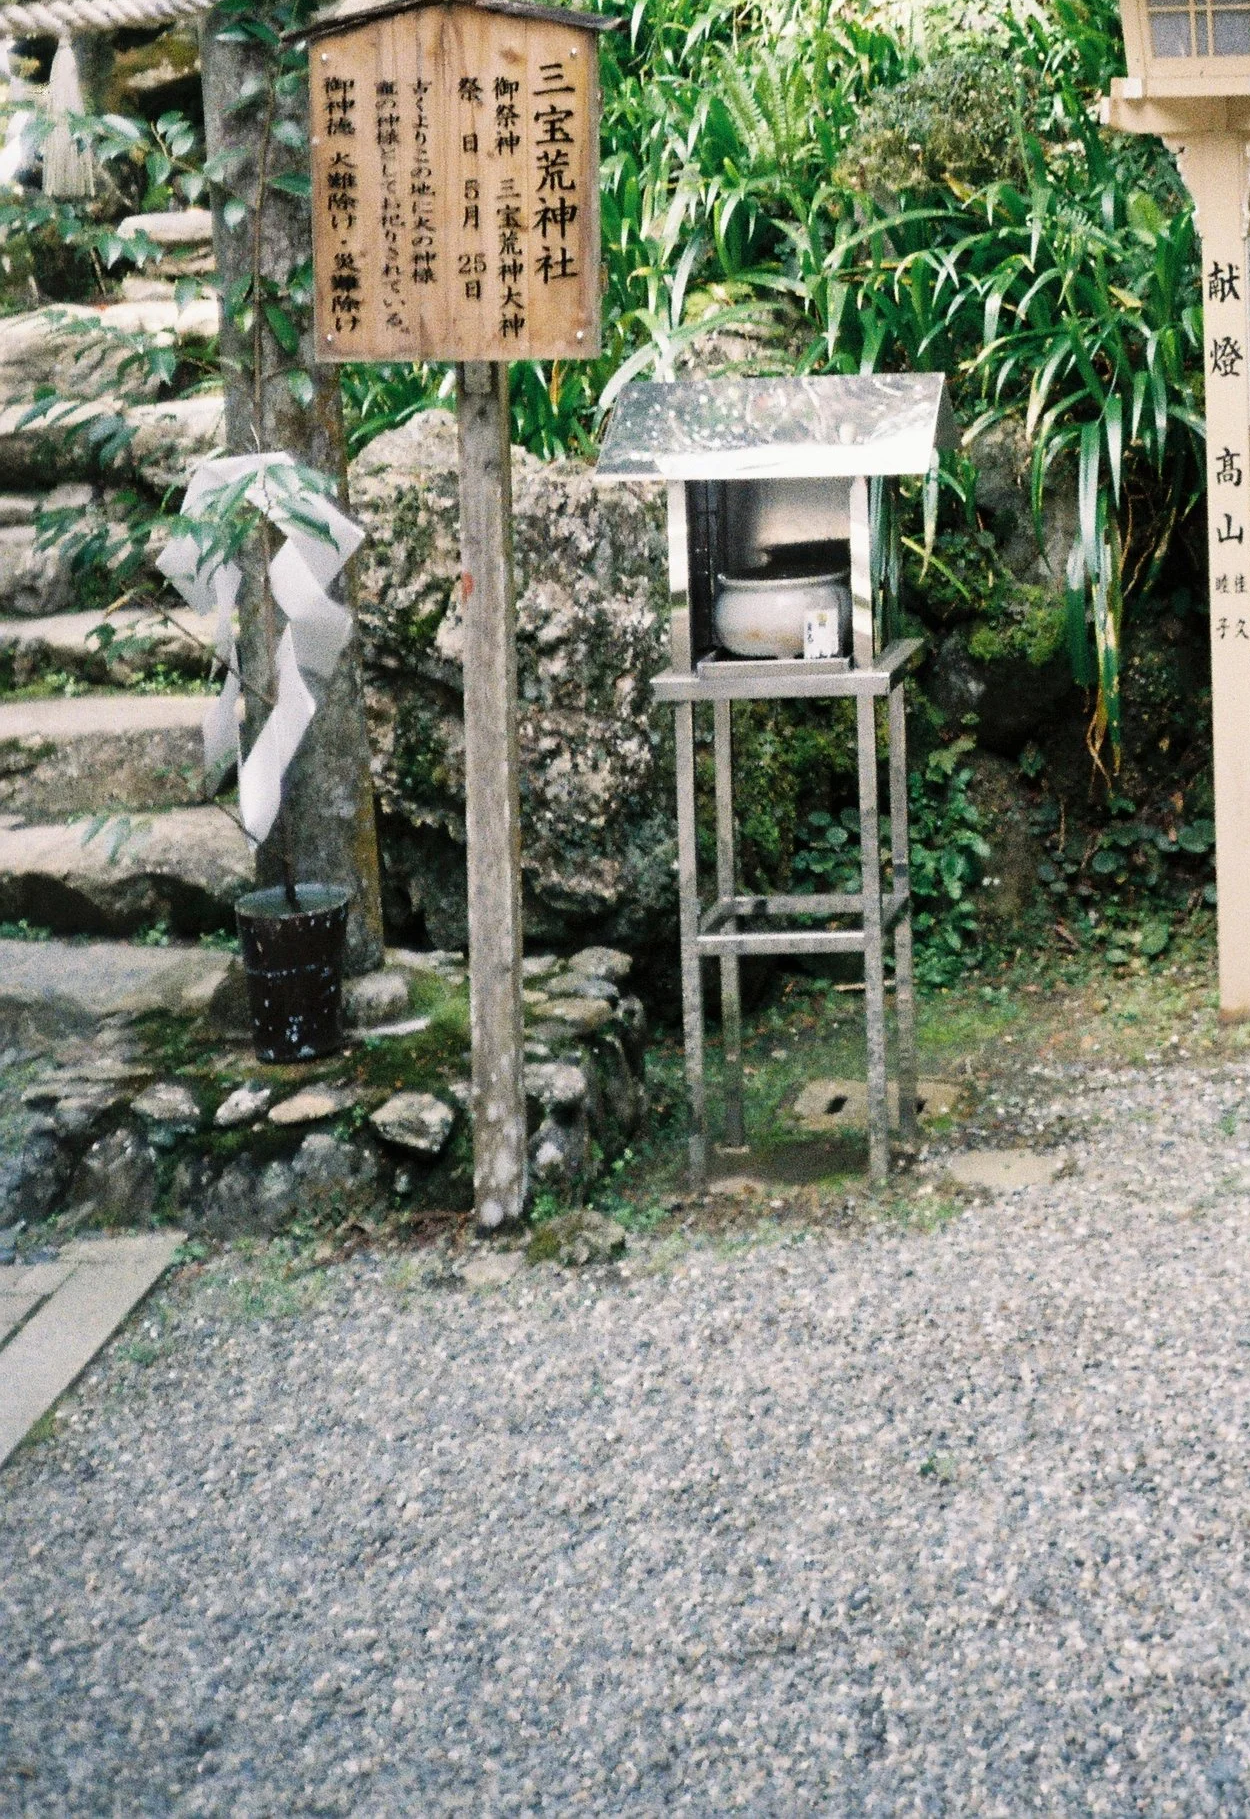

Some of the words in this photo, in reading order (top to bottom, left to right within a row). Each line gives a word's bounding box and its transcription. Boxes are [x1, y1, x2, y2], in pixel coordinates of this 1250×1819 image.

[494, 76, 520, 156] 御祭神
[532, 62, 579, 285] 三宝荒神社
[496, 178, 525, 339] 三宝荒神大神
[1207, 260, 1243, 378] 献燈
